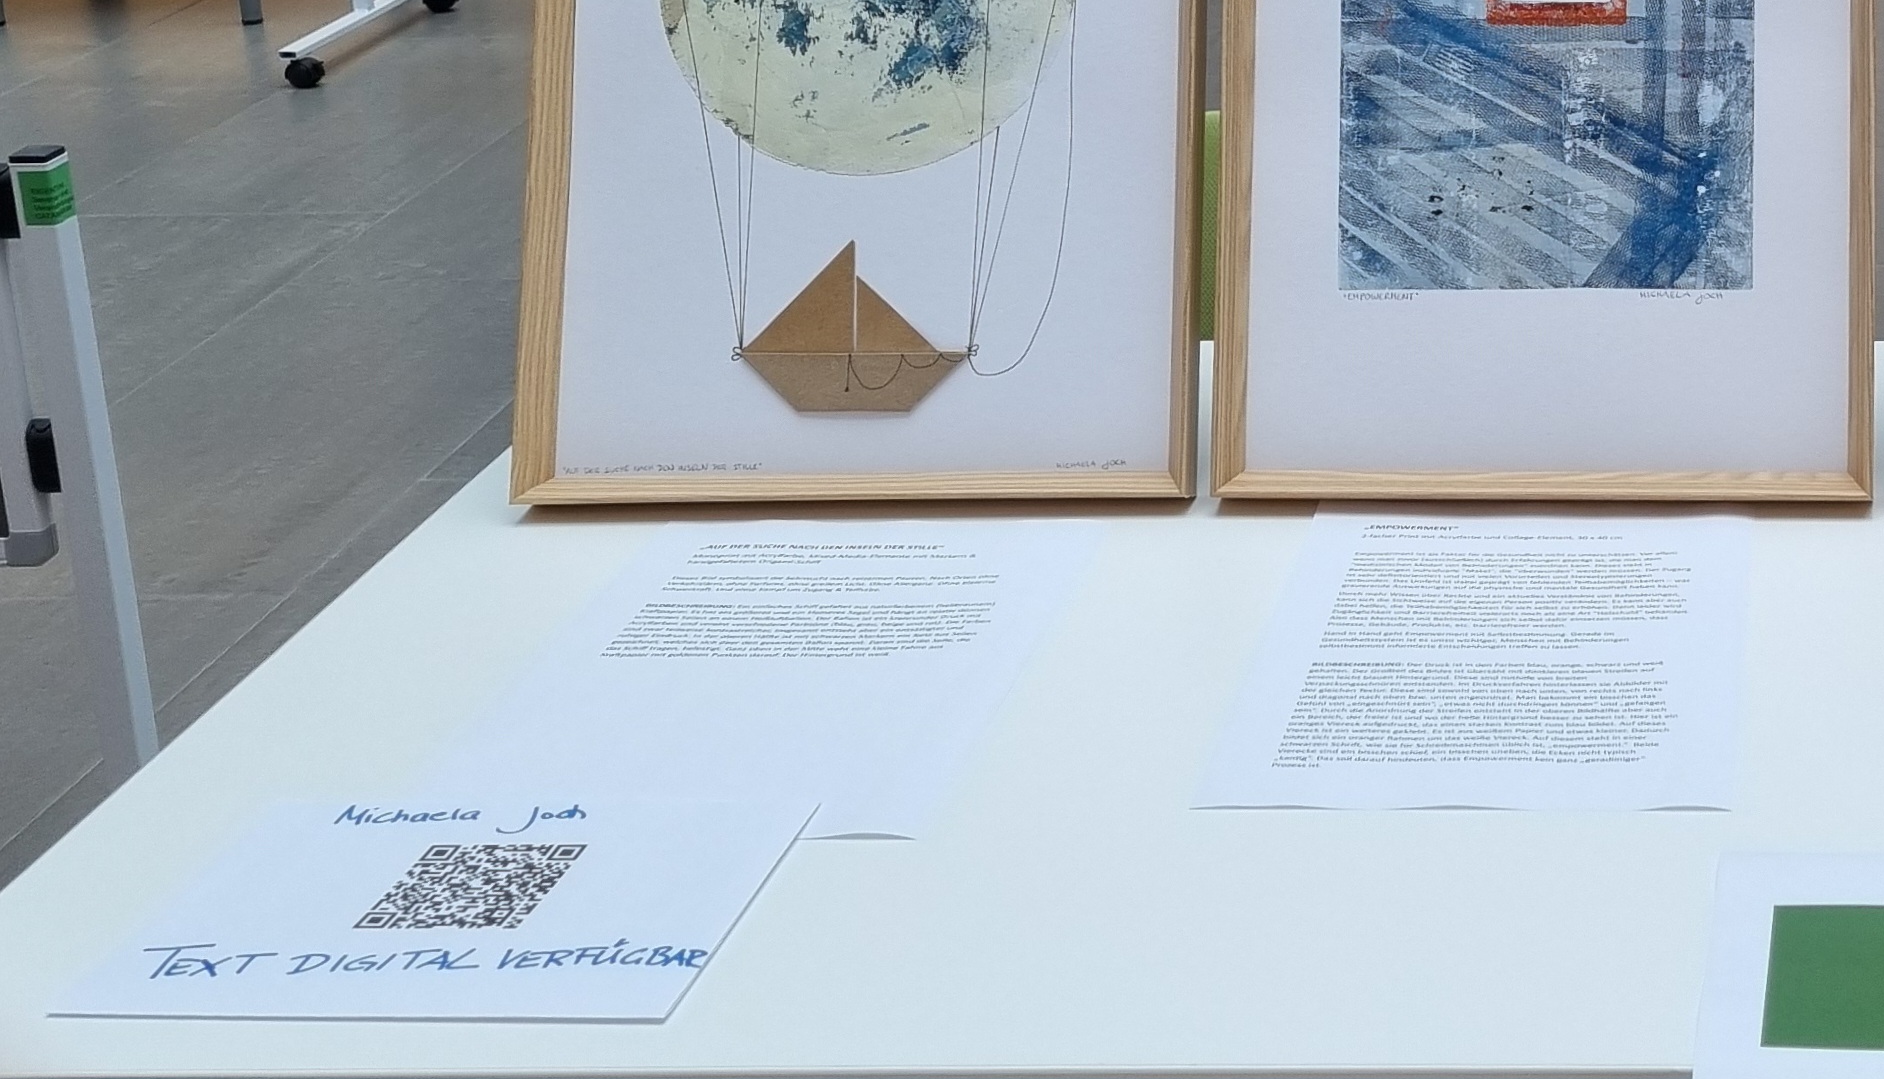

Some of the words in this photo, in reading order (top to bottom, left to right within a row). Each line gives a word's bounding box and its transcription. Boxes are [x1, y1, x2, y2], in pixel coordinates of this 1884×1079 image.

[334, 805, 483, 825] Michaela
[144, 944, 279, 980] TEXT
[287, 947, 480, 976] DIGITAL
[497, 938, 709, 969] VERFÜGBAR
